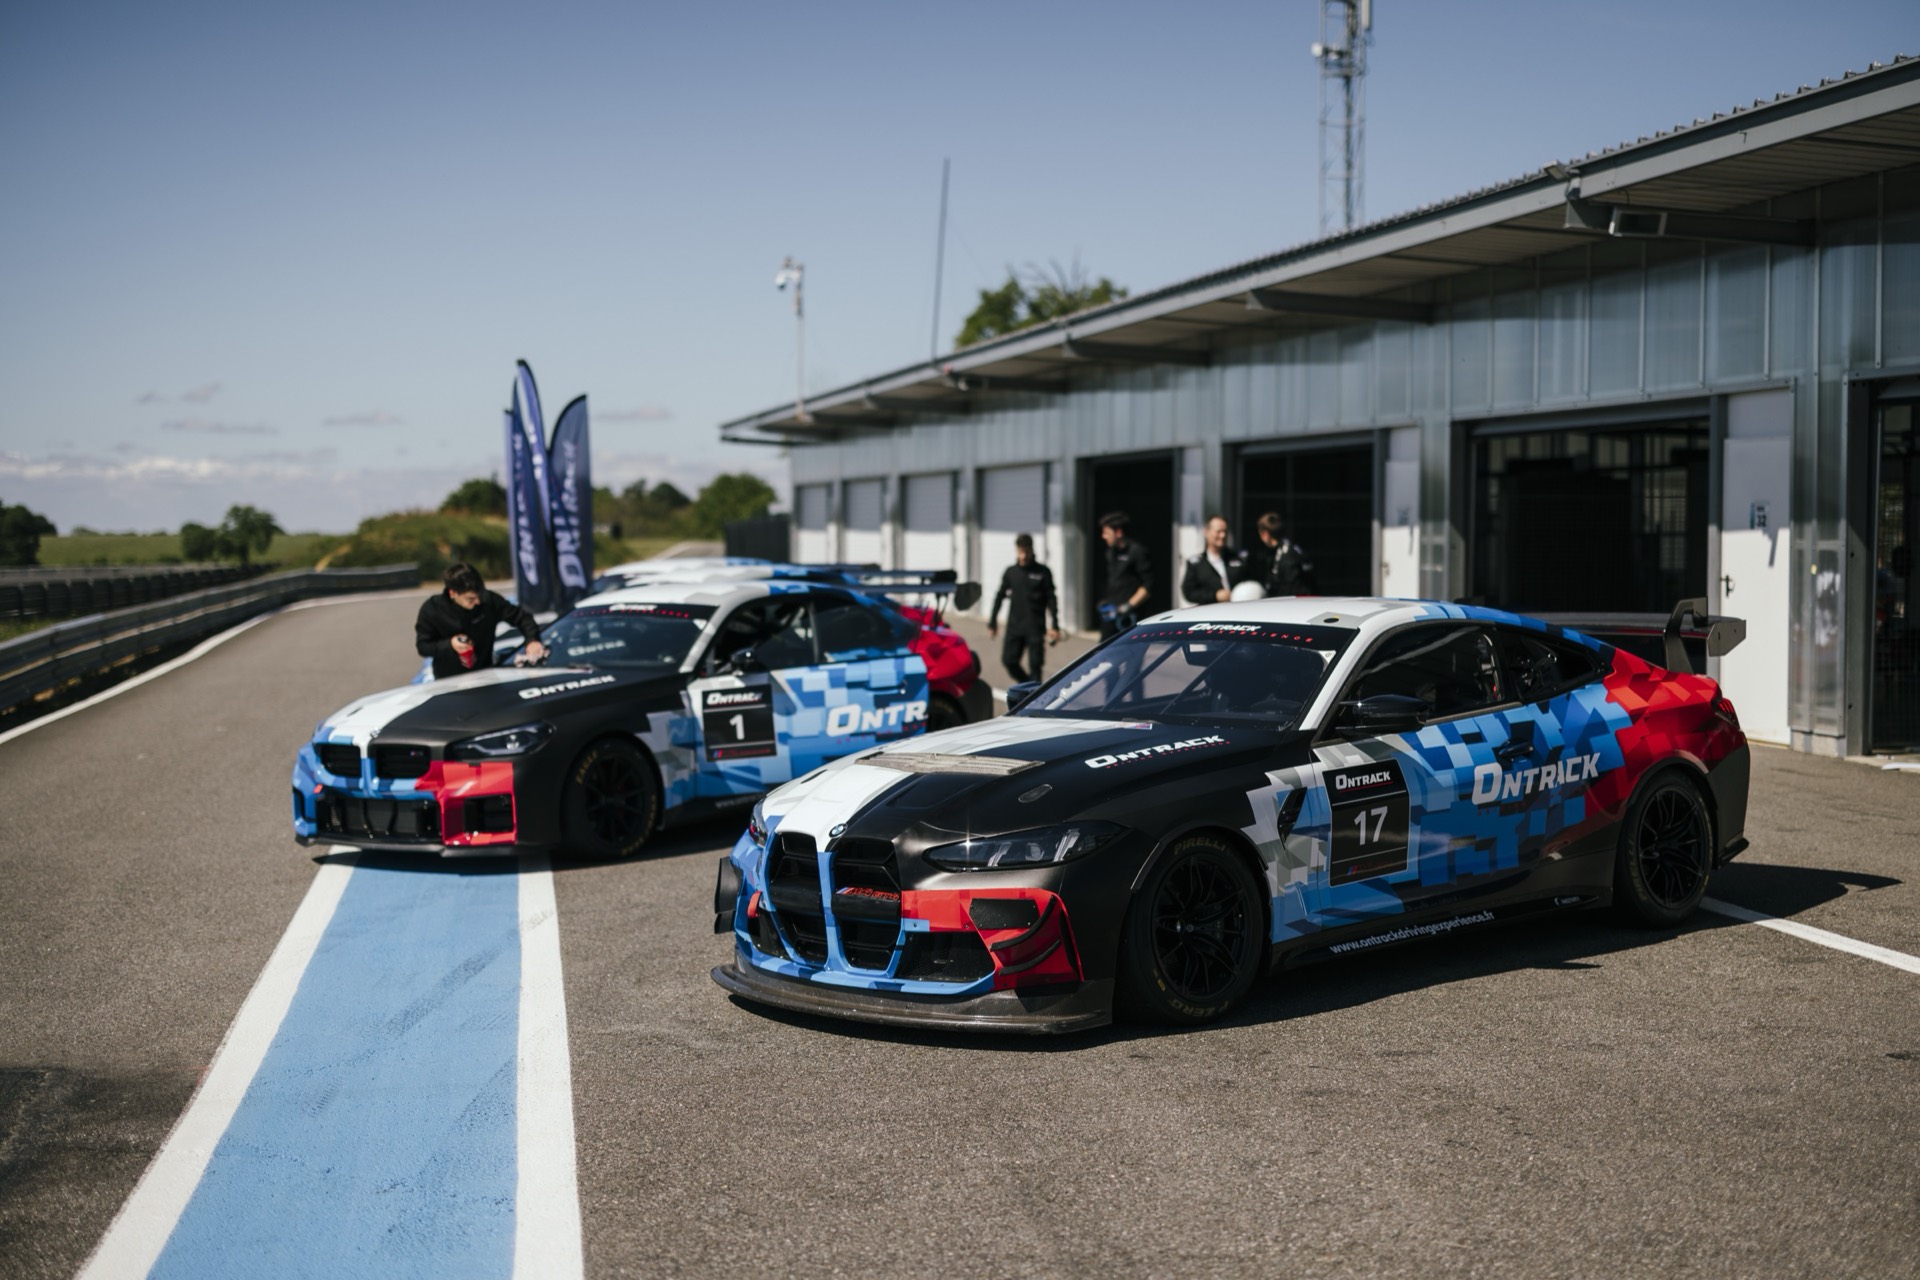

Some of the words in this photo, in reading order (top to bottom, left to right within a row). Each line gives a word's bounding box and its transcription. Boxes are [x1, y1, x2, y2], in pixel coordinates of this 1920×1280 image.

[1188, 623, 1261, 632] ONTRACK
[729, 714, 745, 740] 1
[826, 701, 929, 738] ONTR
[1084, 735, 1225, 768] ONTRACK
[1335, 771, 1391, 790] ONTRACK
[1472, 752, 1600, 805] ONTRACK
[1354, 806, 1388, 846] 17
[1329, 910, 1495, 954] www.ontrackdrivingexperience.fr
